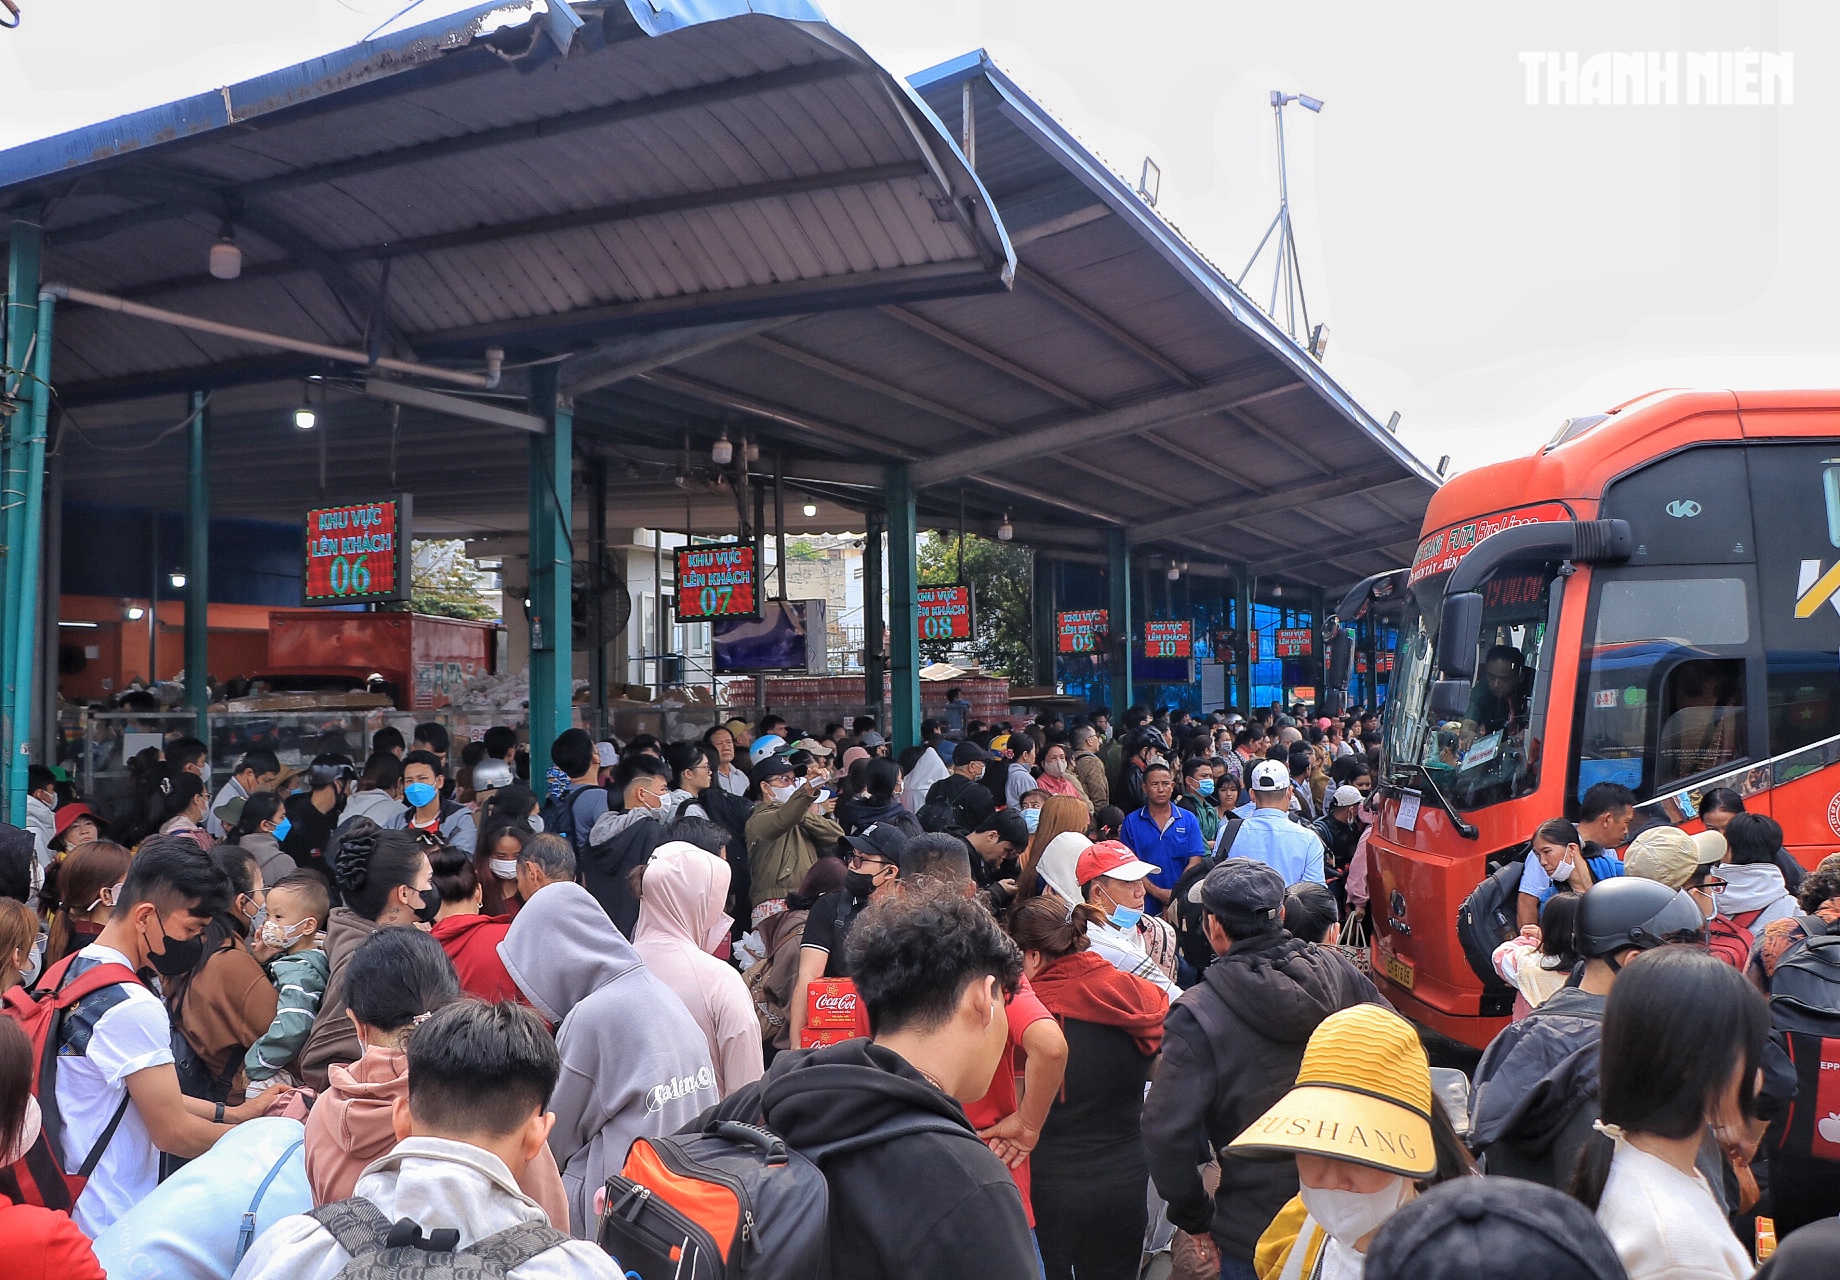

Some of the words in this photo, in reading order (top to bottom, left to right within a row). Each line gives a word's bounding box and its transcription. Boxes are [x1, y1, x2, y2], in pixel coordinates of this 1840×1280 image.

[318, 511, 349, 531] KHU
[351, 506, 382, 530] VỰC
[311, 534, 339, 557] LÊN
[341, 530, 391, 555] KHÁCH
[1445, 523, 1477, 552] FUTA
[687, 553, 713, 568] KHU
[715, 549, 742, 568] VỰC
[329, 555, 371, 594] 06
[682, 570, 706, 588] LÊN
[708, 567, 750, 586] KHÁCH
[700, 585, 734, 616] 07
[937, 588, 958, 603] VỰC
[931, 601, 966, 616] KHÁCH
[924, 616, 953, 638] 08
[1162, 632, 1188, 641] KHÁCH
[1158, 641, 1176, 656] 10
[815, 993, 857, 1010] Coca-Col
[1820, 1060, 1840, 1071] EPP
[1247, 1116, 1417, 1160] FUSHANG
